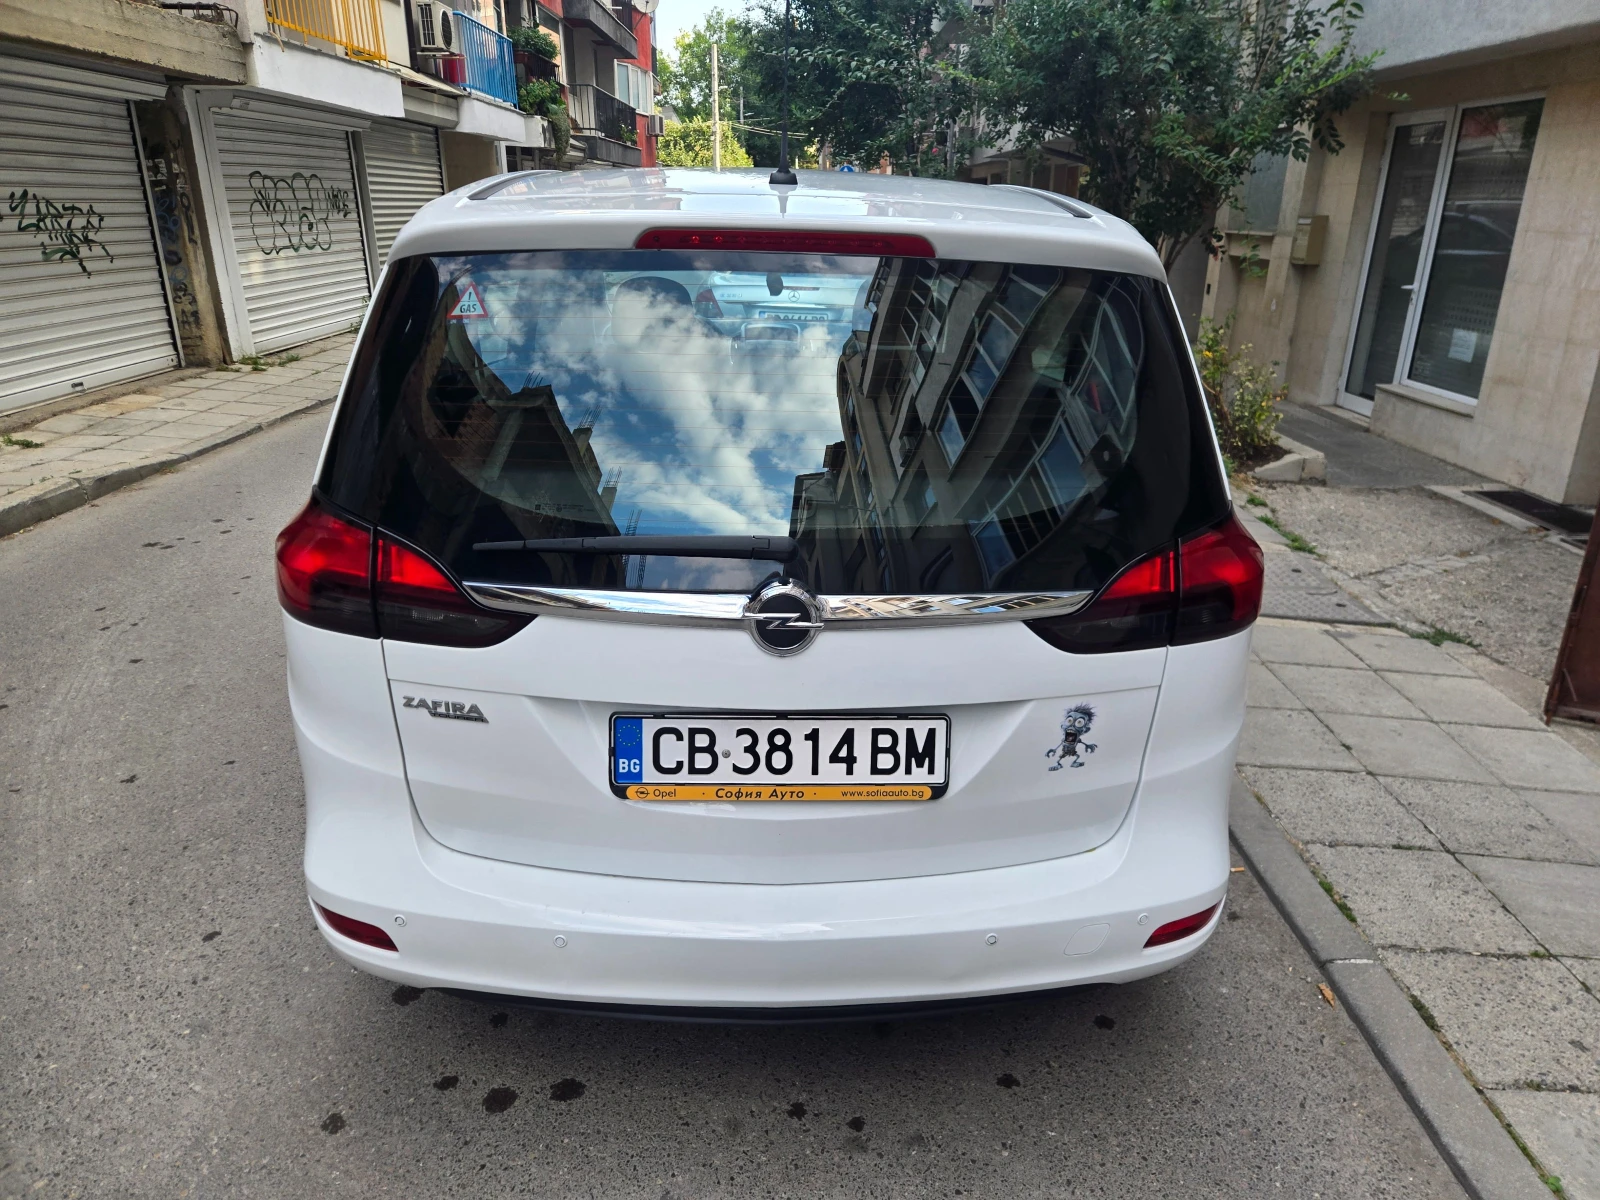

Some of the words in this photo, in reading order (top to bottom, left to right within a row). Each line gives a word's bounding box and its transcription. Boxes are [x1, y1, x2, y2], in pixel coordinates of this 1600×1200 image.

[460, 303, 477, 314] GAS
[402, 695, 485, 717] ZAFIRA
[652, 726, 719, 775] CB
[732, 727, 858, 776] 3814
[870, 727, 937, 776] BM
[618, 758, 641, 773] BG
[652, 788, 677, 798] Opel
[715, 787, 763, 800] София
[768, 788, 806, 800] Ауто
[841, 788, 924, 798] www.sofiaauto.bg
